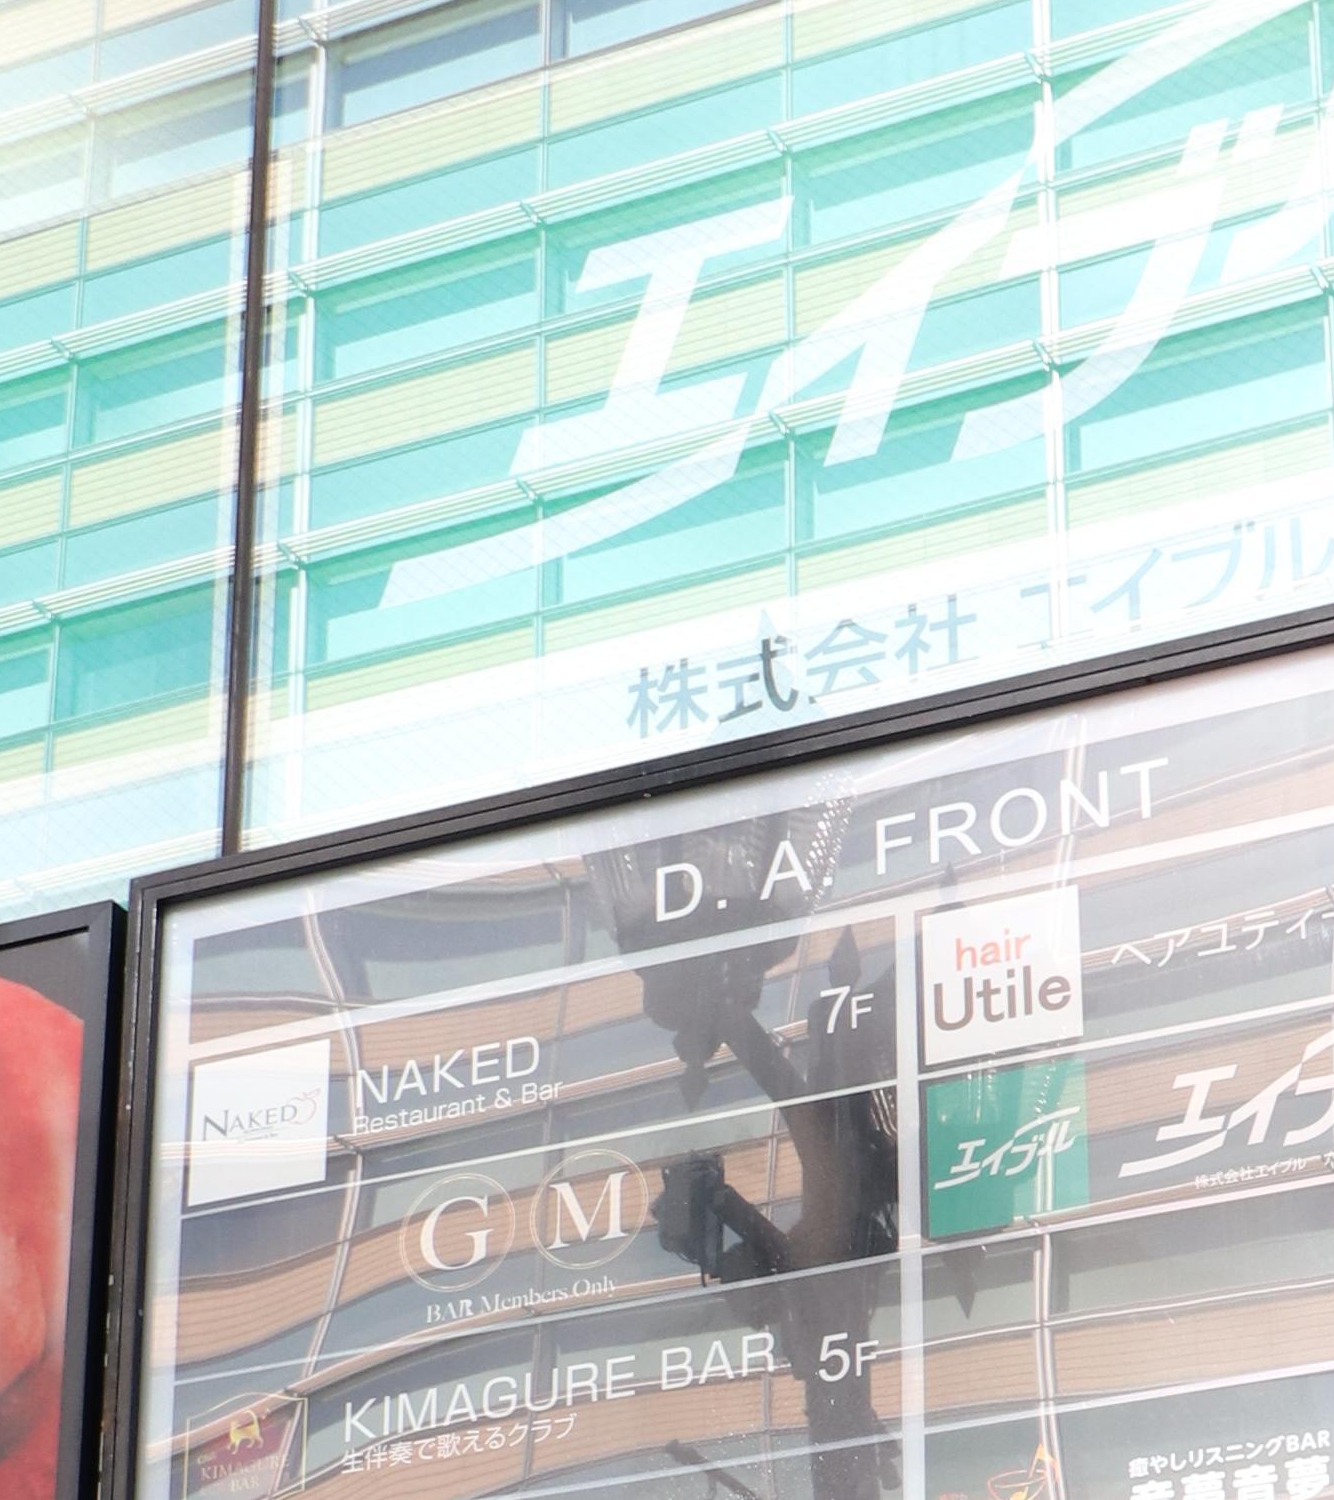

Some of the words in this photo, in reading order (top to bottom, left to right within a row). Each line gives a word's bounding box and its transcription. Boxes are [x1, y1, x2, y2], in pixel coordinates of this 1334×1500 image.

[626, 596, 978, 741] 株式会社
[875, 756, 1171, 876] FRONT
[953, 928, 1032, 972] hair
[818, 988, 875, 1038] 7F
[932, 965, 1072, 1032] Utile
[354, 1035, 541, 1109] NAKED
[201, 1100, 300, 1143] NAKED
[353, 1096, 487, 1138] Restaurant
[494, 1086, 513, 1109] &
[521, 1076, 565, 1104] Bar
[933, 1104, 1081, 1190] エイブル
[1193, 1156, 1307, 1190] 株式会社エイブル
[419, 1194, 496, 1272] G
[547, 1169, 631, 1251] M
[425, 1299, 473, 1325] BAR
[480, 1281, 569, 1317] Members
[571, 1274, 618, 1301] Only
[342, 1352, 637, 1443] KIMAGURE
[659, 1330, 777, 1394] BAR
[817, 1333, 882, 1386] 5F
[341, 1412, 578, 1476] 生伴奏で歌えるクラブ
[1127, 1429, 1331, 1480] 癒やしリスニングBAR
